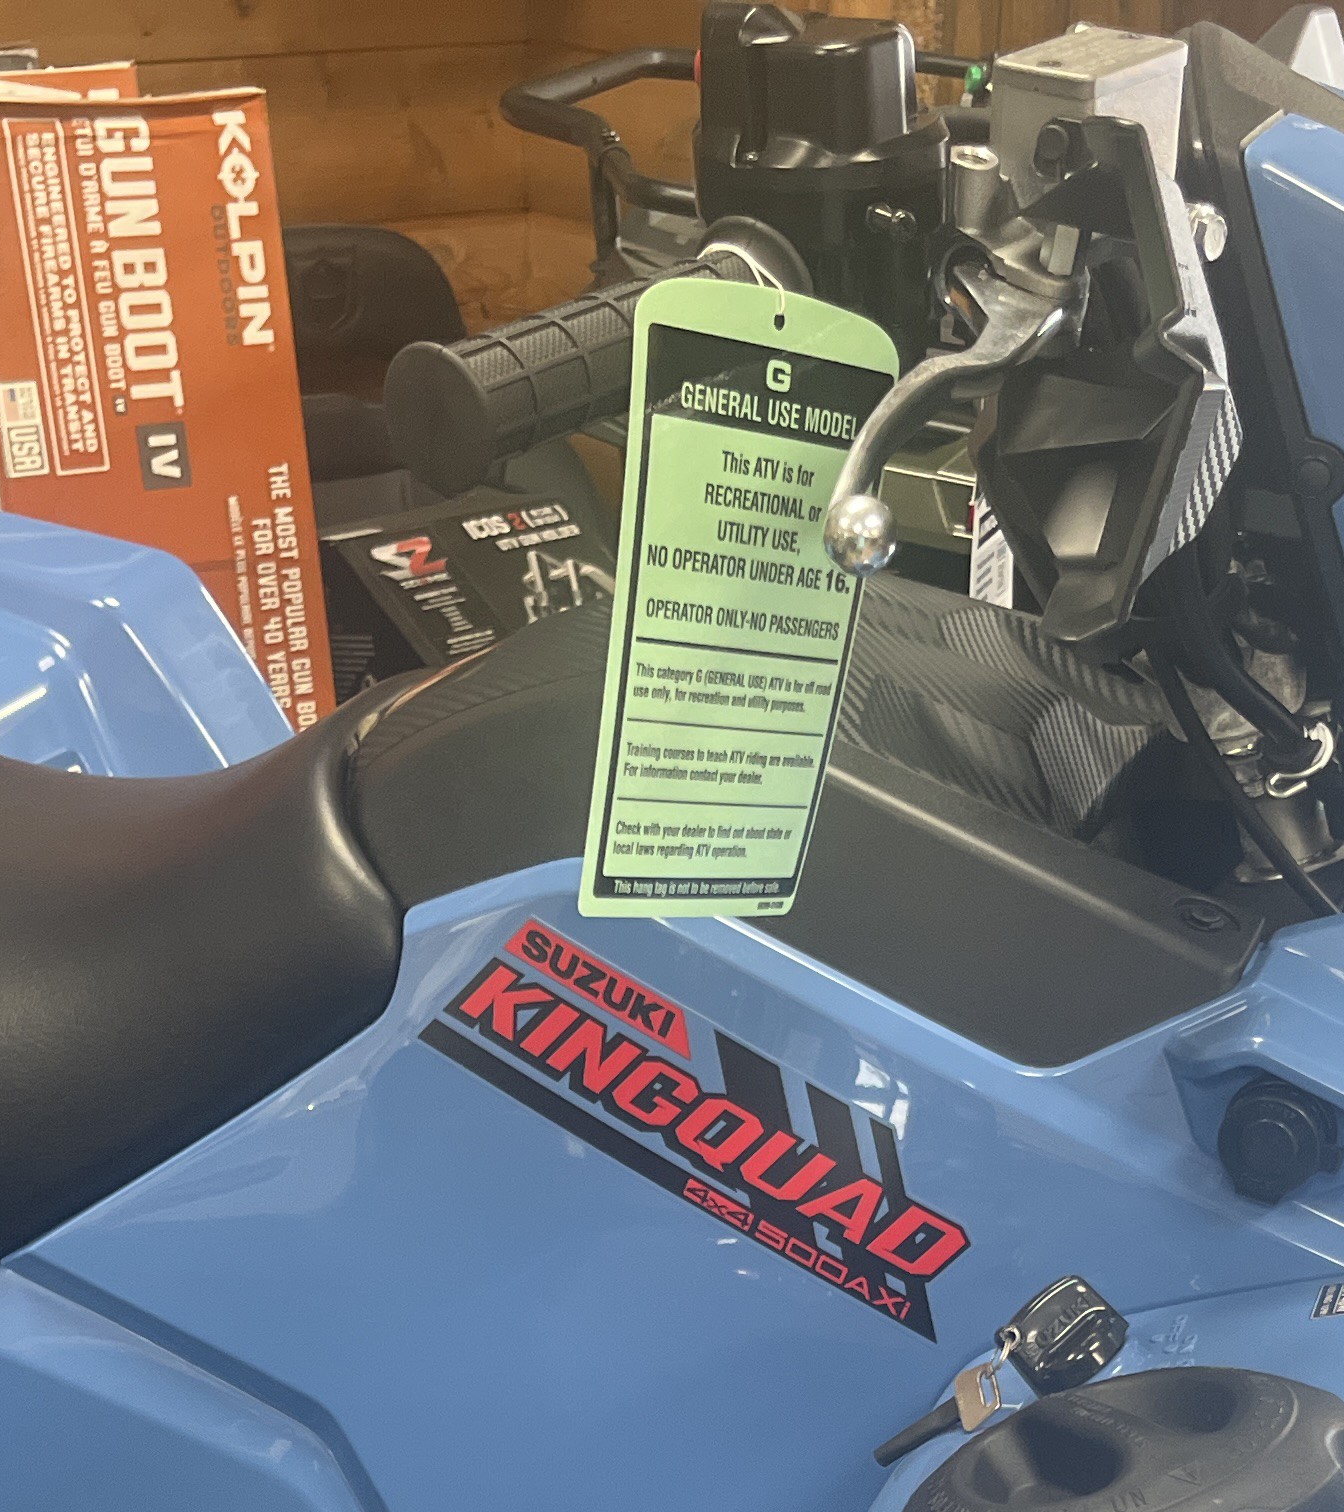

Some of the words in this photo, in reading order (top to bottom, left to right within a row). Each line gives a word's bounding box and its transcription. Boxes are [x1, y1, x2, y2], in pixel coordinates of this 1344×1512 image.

[25, 132, 50, 228] SECURE
[93, 116, 162, 238] GUN
[40, 132, 73, 271] ENGINEERED
[212, 110, 275, 346] KOLPIN
[38, 229, 69, 336] FIREARMS
[60, 273, 77, 305] TO
[97, 300, 119, 338] GUN
[110, 247, 184, 409] BOOT
[55, 337, 71, 360] IN
[64, 308, 92, 404] PROTECT
[765, 359, 792, 392] G
[58, 362, 85, 454] TRANSIT
[681, 381, 762, 423] GENERAL
[767, 398, 801, 430] USE
[7, 425, 43, 473] USA
[80, 409, 100, 453] AND
[147, 432, 182, 479] IV
[722, 450, 750, 475] This
[752, 456, 781, 482] ATV
[783, 461, 794, 485] is
[796, 463, 816, 488] for
[268, 462, 292, 500] THE
[704, 482, 805, 520] RECREATIONAL
[808, 504, 823, 522] or
[251, 517, 275, 556] FOR
[274, 506, 299, 561] MOST
[717, 519, 770, 548] UTILITY
[257, 561, 281, 612] OVER
[646, 543, 668, 567] NO
[672, 547, 746, 579] OPERATOR
[749, 560, 794, 586] UNDER
[796, 566, 822, 590] AGE
[825, 568, 850, 595] 16.
[263, 615, 284, 645] 40
[281, 566, 309, 653] POPULAR
[646, 598, 714, 625] OPERATOR
[769, 614, 840, 641] PASSENGERS
[291, 656, 314, 696] GUN
[633, 685, 650, 698] use
[674, 688, 687, 701] for
[688, 690, 730, 706] recreation
[731, 694, 747, 707] and
[636, 662, 655, 678] This
[656, 666, 694, 685] category
[695, 669, 703, 683] G
[704, 669, 745, 688] (GENERAL
[768, 676, 784, 692] ATV
[784, 678, 792, 692] is
[623, 762, 639, 777] For
[640, 764, 688, 781] information
[689, 769, 719, 782] contact
[719, 772, 737, 785] your
[627, 742, 661, 761] Training
[663, 747, 695, 761] courses
[696, 749, 705, 761] to
[706, 749, 728, 762] teach
[729, 750, 746, 764] ATV
[746, 752, 767, 768] riding
[613, 841, 634, 855] local
[635, 842, 655, 855] laws
[656, 843, 694, 859] regarding
[695, 843, 711, 856] ATV
[615, 820, 642, 835] Check
[643, 822, 661, 836] with
[662, 825, 681, 839] your
[681, 824, 707, 838] dealer
[707, 826, 716, 838] to
[614, 879, 632, 894] This
[633, 880, 653, 896] hang
[655, 882, 667, 897] tag
[710, 881, 741, 895] removed
[519, 927, 676, 1040] SUZUKI
[457, 964, 972, 1277] KINGQUAD
